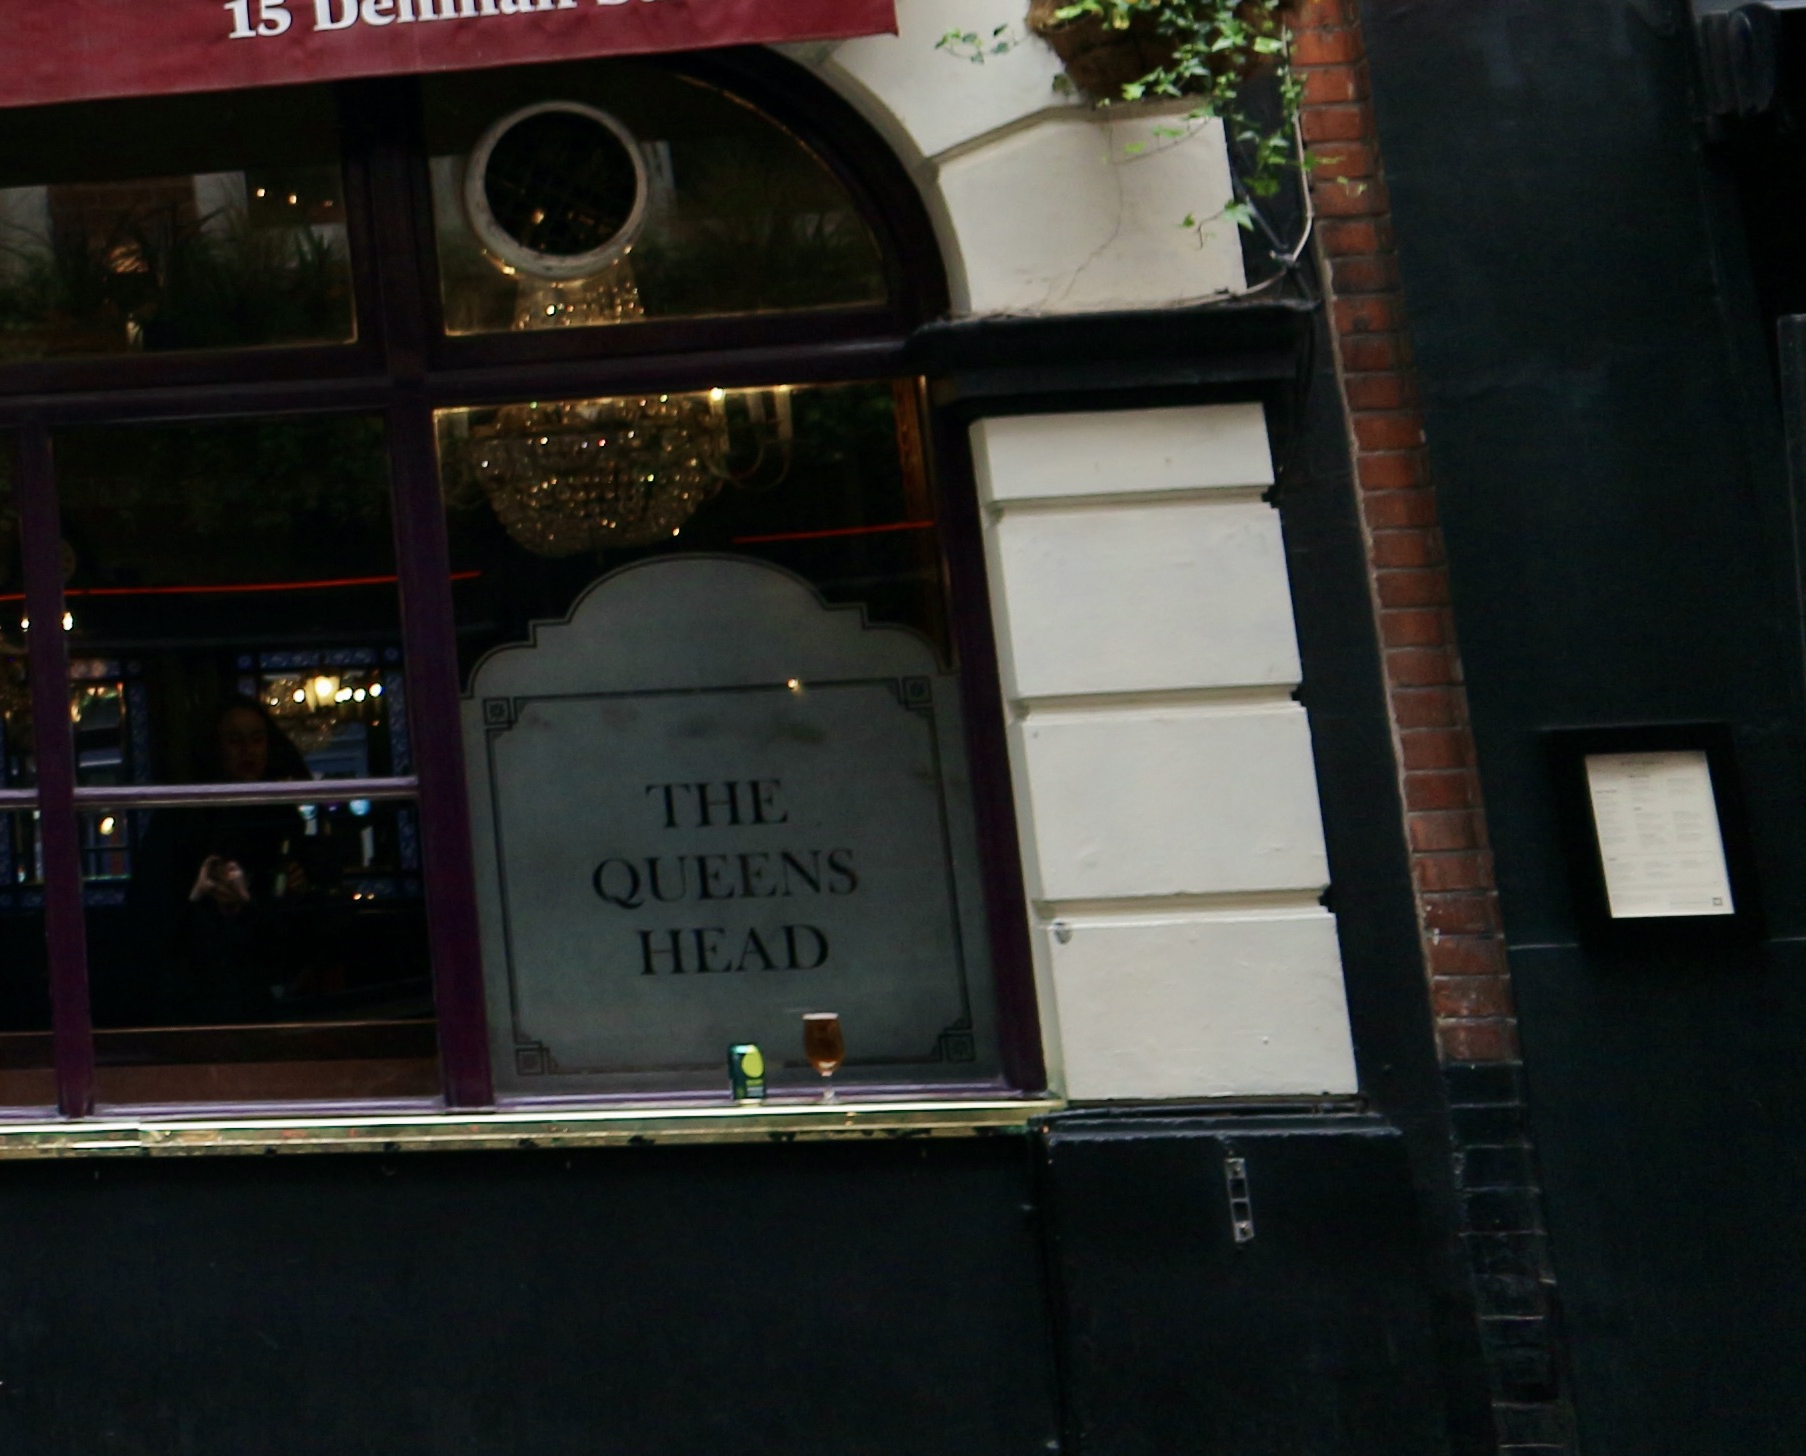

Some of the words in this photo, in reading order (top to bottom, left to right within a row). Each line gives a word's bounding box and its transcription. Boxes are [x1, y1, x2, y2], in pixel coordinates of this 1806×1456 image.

[645, 777, 789, 830] THE
[591, 847, 860, 911] QUEENS
[638, 922, 830, 977] HEAD
